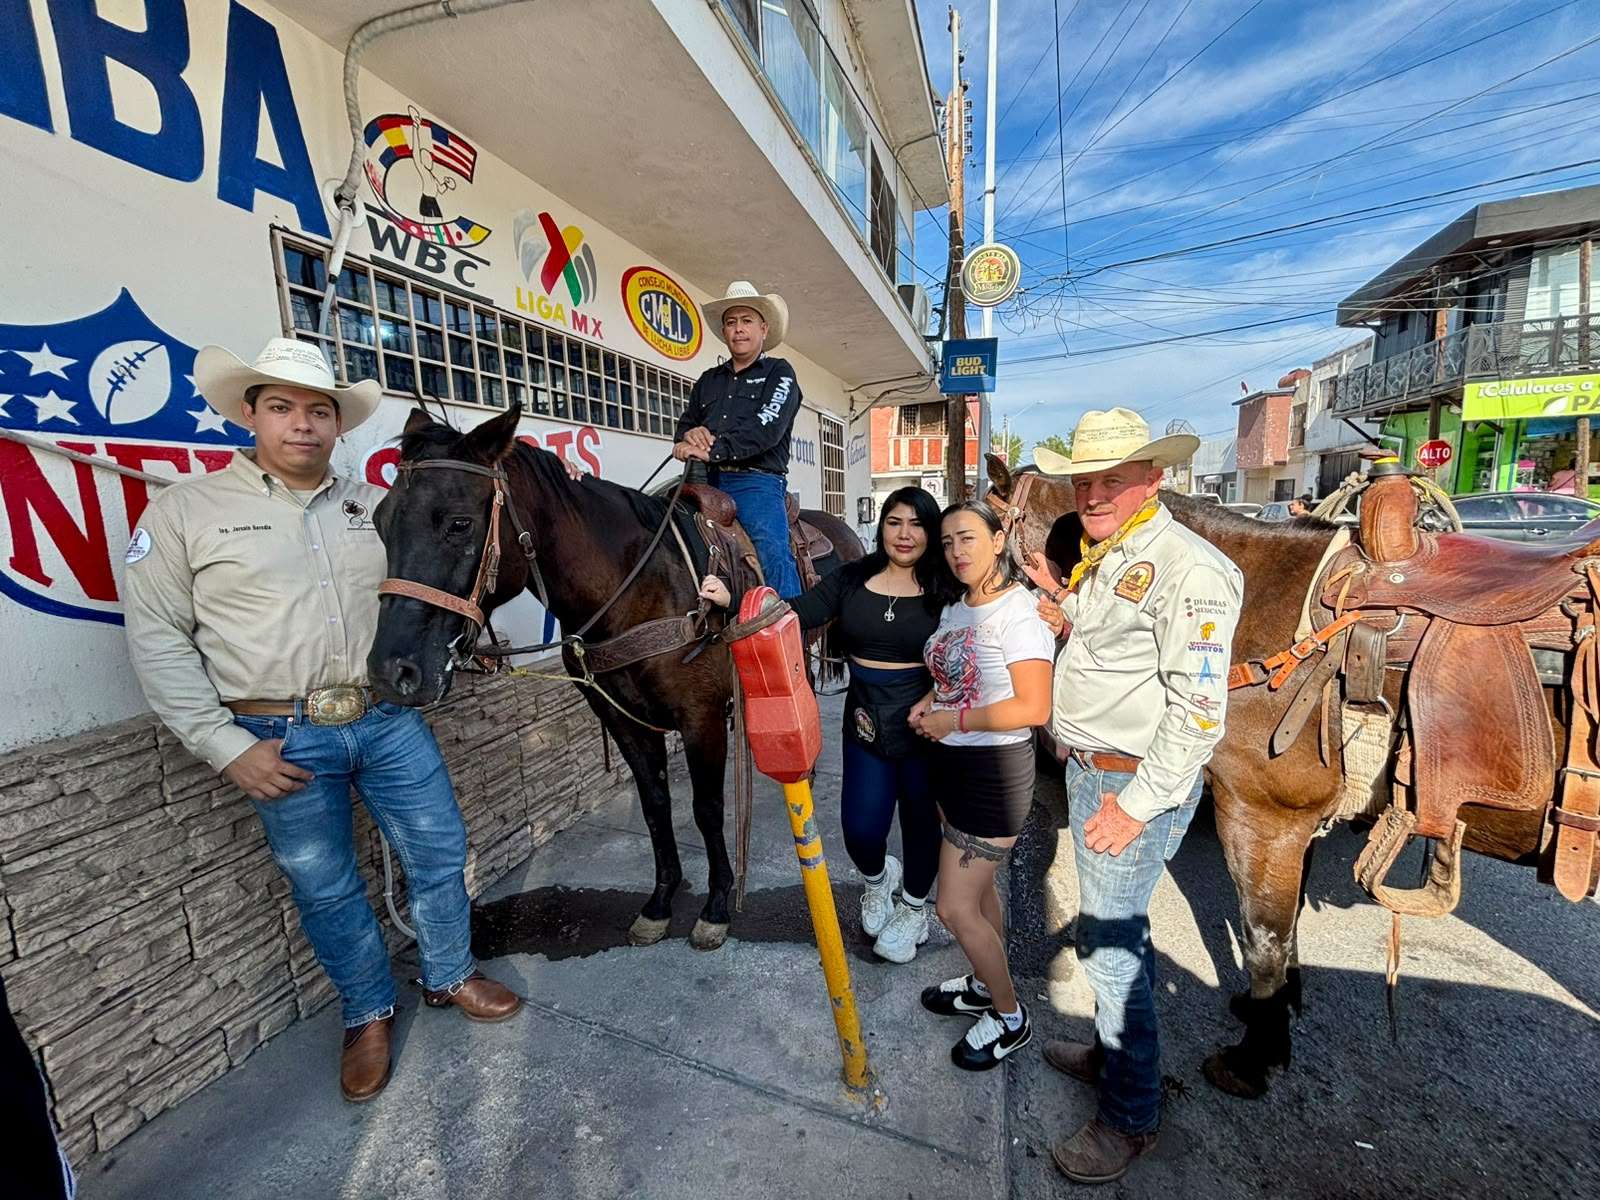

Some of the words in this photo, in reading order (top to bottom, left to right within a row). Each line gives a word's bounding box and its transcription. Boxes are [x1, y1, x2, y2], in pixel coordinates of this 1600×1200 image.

[365, 214, 480, 288] WBC
[638, 276, 665, 289] CONSEJO
[515, 286, 569, 327] LIGA
[571, 308, 604, 340] MX
[956, 356, 982, 366] BUD
[951, 365, 986, 376] LIGHT
[1420, 447, 1451, 460] ALTO
[0, 436, 235, 602] NF
